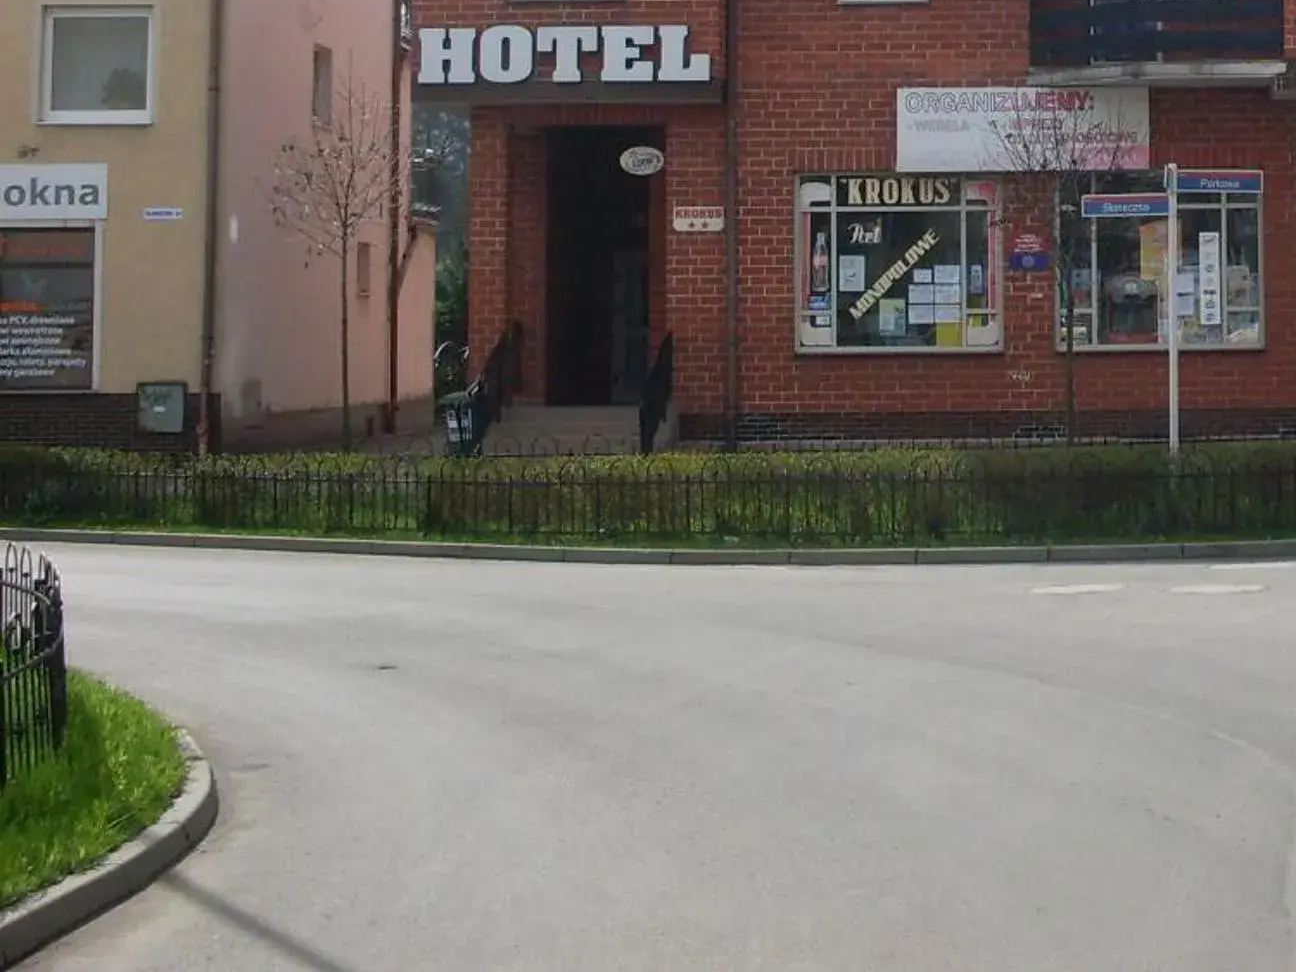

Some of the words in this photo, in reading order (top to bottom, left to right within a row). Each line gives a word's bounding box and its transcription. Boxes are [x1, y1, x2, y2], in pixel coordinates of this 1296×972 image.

[418, 25, 710, 84] HOTEL
[905, 90, 1095, 113] ORGANIZUJEMY:
[3, 177, 100, 206] okna
